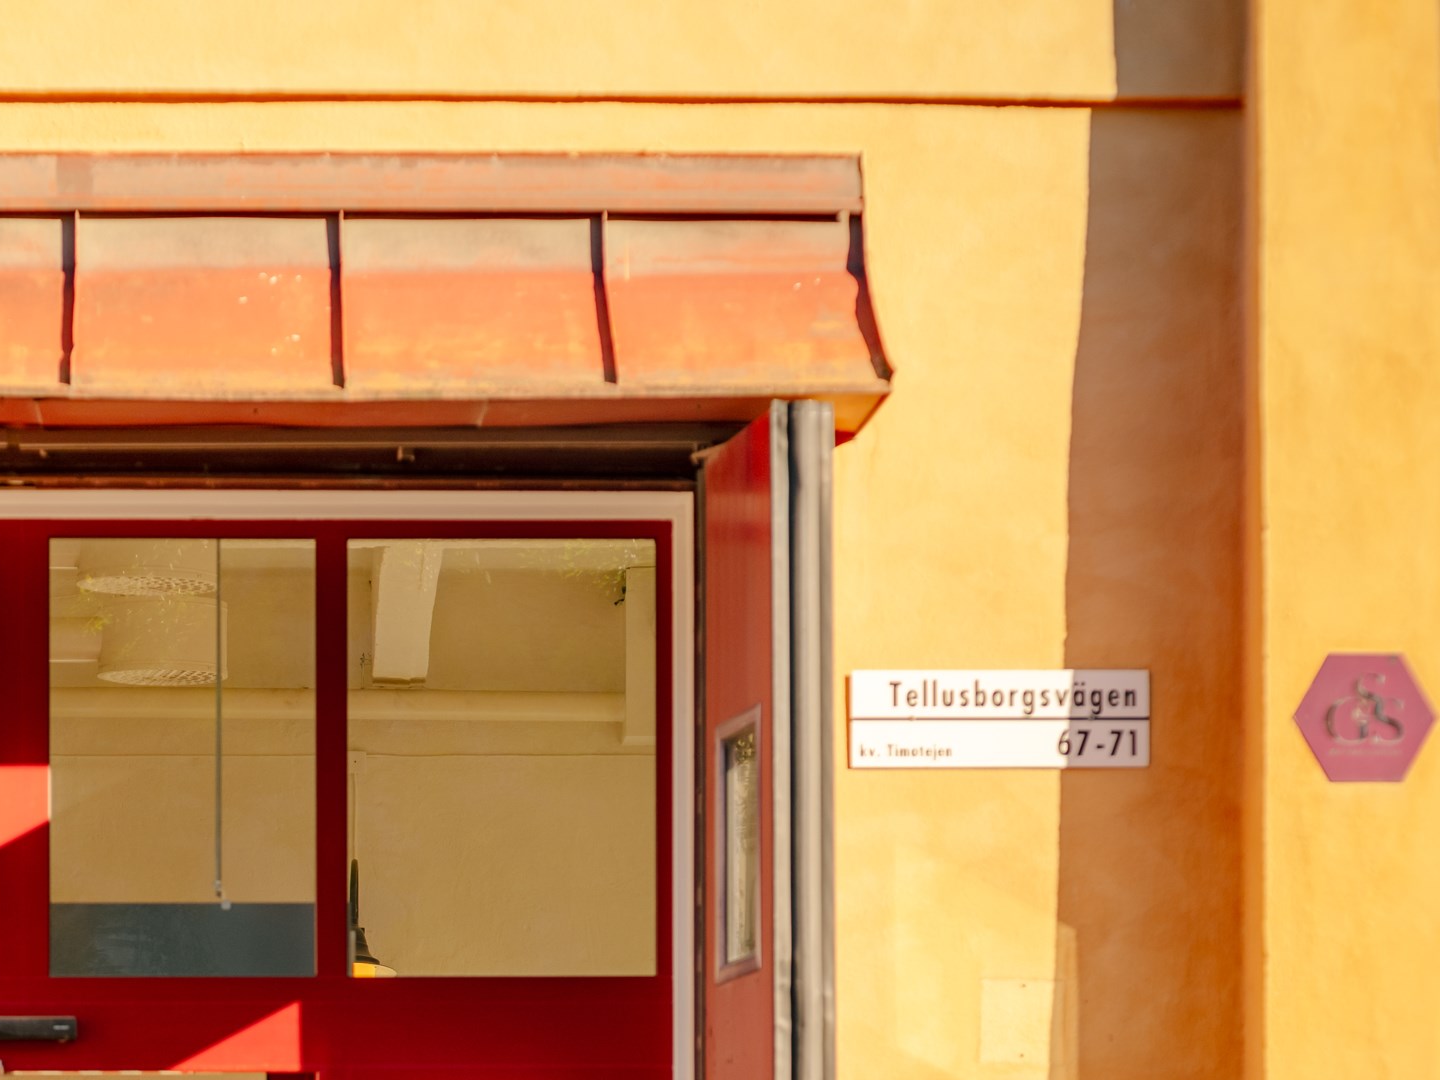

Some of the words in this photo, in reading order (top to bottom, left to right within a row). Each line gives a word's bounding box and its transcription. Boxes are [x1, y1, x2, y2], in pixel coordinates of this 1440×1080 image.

[889, 679, 1138, 716] Tellusborgsvägen
[859, 744, 880, 757] kv.
[887, 744, 953, 761] Timotejen
[1057, 730, 1138, 757] 67-71
